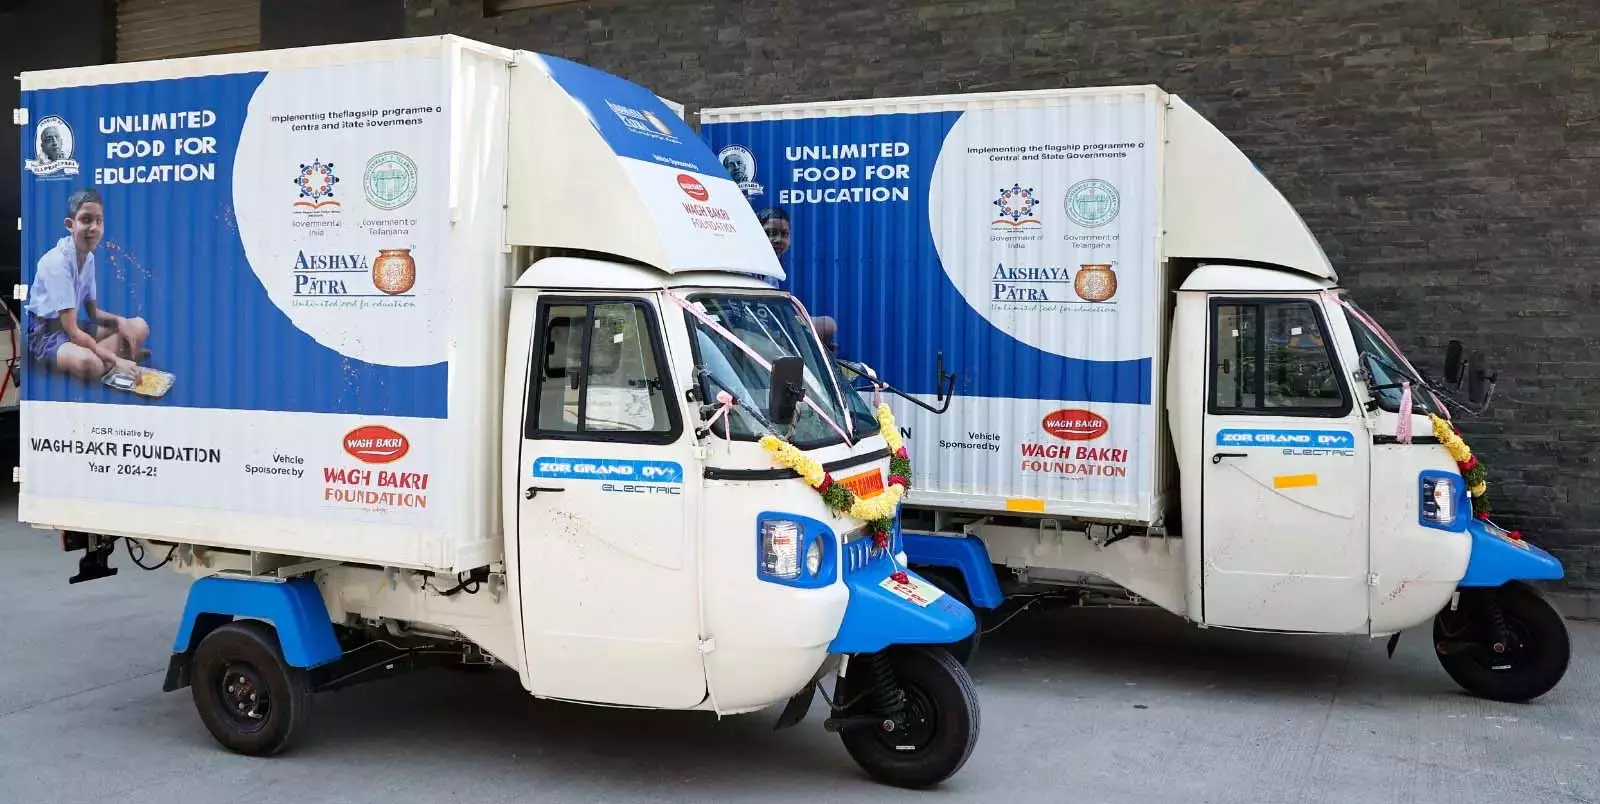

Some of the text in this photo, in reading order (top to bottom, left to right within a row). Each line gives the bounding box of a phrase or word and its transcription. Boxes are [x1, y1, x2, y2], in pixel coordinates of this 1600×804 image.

[99, 110, 216, 134] UNLIMITED
[328, 111, 343, 119] the
[366, 118, 423, 127] overnmens
[106, 136, 217, 159] FOOD FOR
[785, 142, 910, 161] UNLIMITED
[967, 146, 1026, 154] Implementing
[1044, 143, 1080, 152] flagship
[1083, 142, 1136, 151] programme
[95, 163, 215, 184] EDUCATION
[793, 164, 910, 183] FOOD FOR
[779, 186, 909, 204] EDUCATION
[992, 262, 1070, 280] AKSHAYA
[1046, 419, 1102, 428] WAGH BAKRI
[143, 430, 154, 439] by
[968, 431, 1001, 441] Vehicle
[1222, 433, 1254, 442] ZOR
[1255, 433, 1311, 443] GRAND
[31, 437, 221, 463] WAGH BAKR FOUNDATION
[347, 438, 402, 448] WAGH BAKRI
[939, 440, 1000, 452] Sponsored by
[272, 454, 304, 464] Vehcle
[1021, 443, 1129, 463] WAGH BAKRI
[291, 467, 304, 478] by
[539, 462, 571, 473] ZOR
[573, 463, 634, 476] GRAND
[1021, 460, 1126, 477] FOUNDATION
[323, 467, 429, 490] WAGH BAKRI
[324, 487, 427, 508] FOUNDATION
